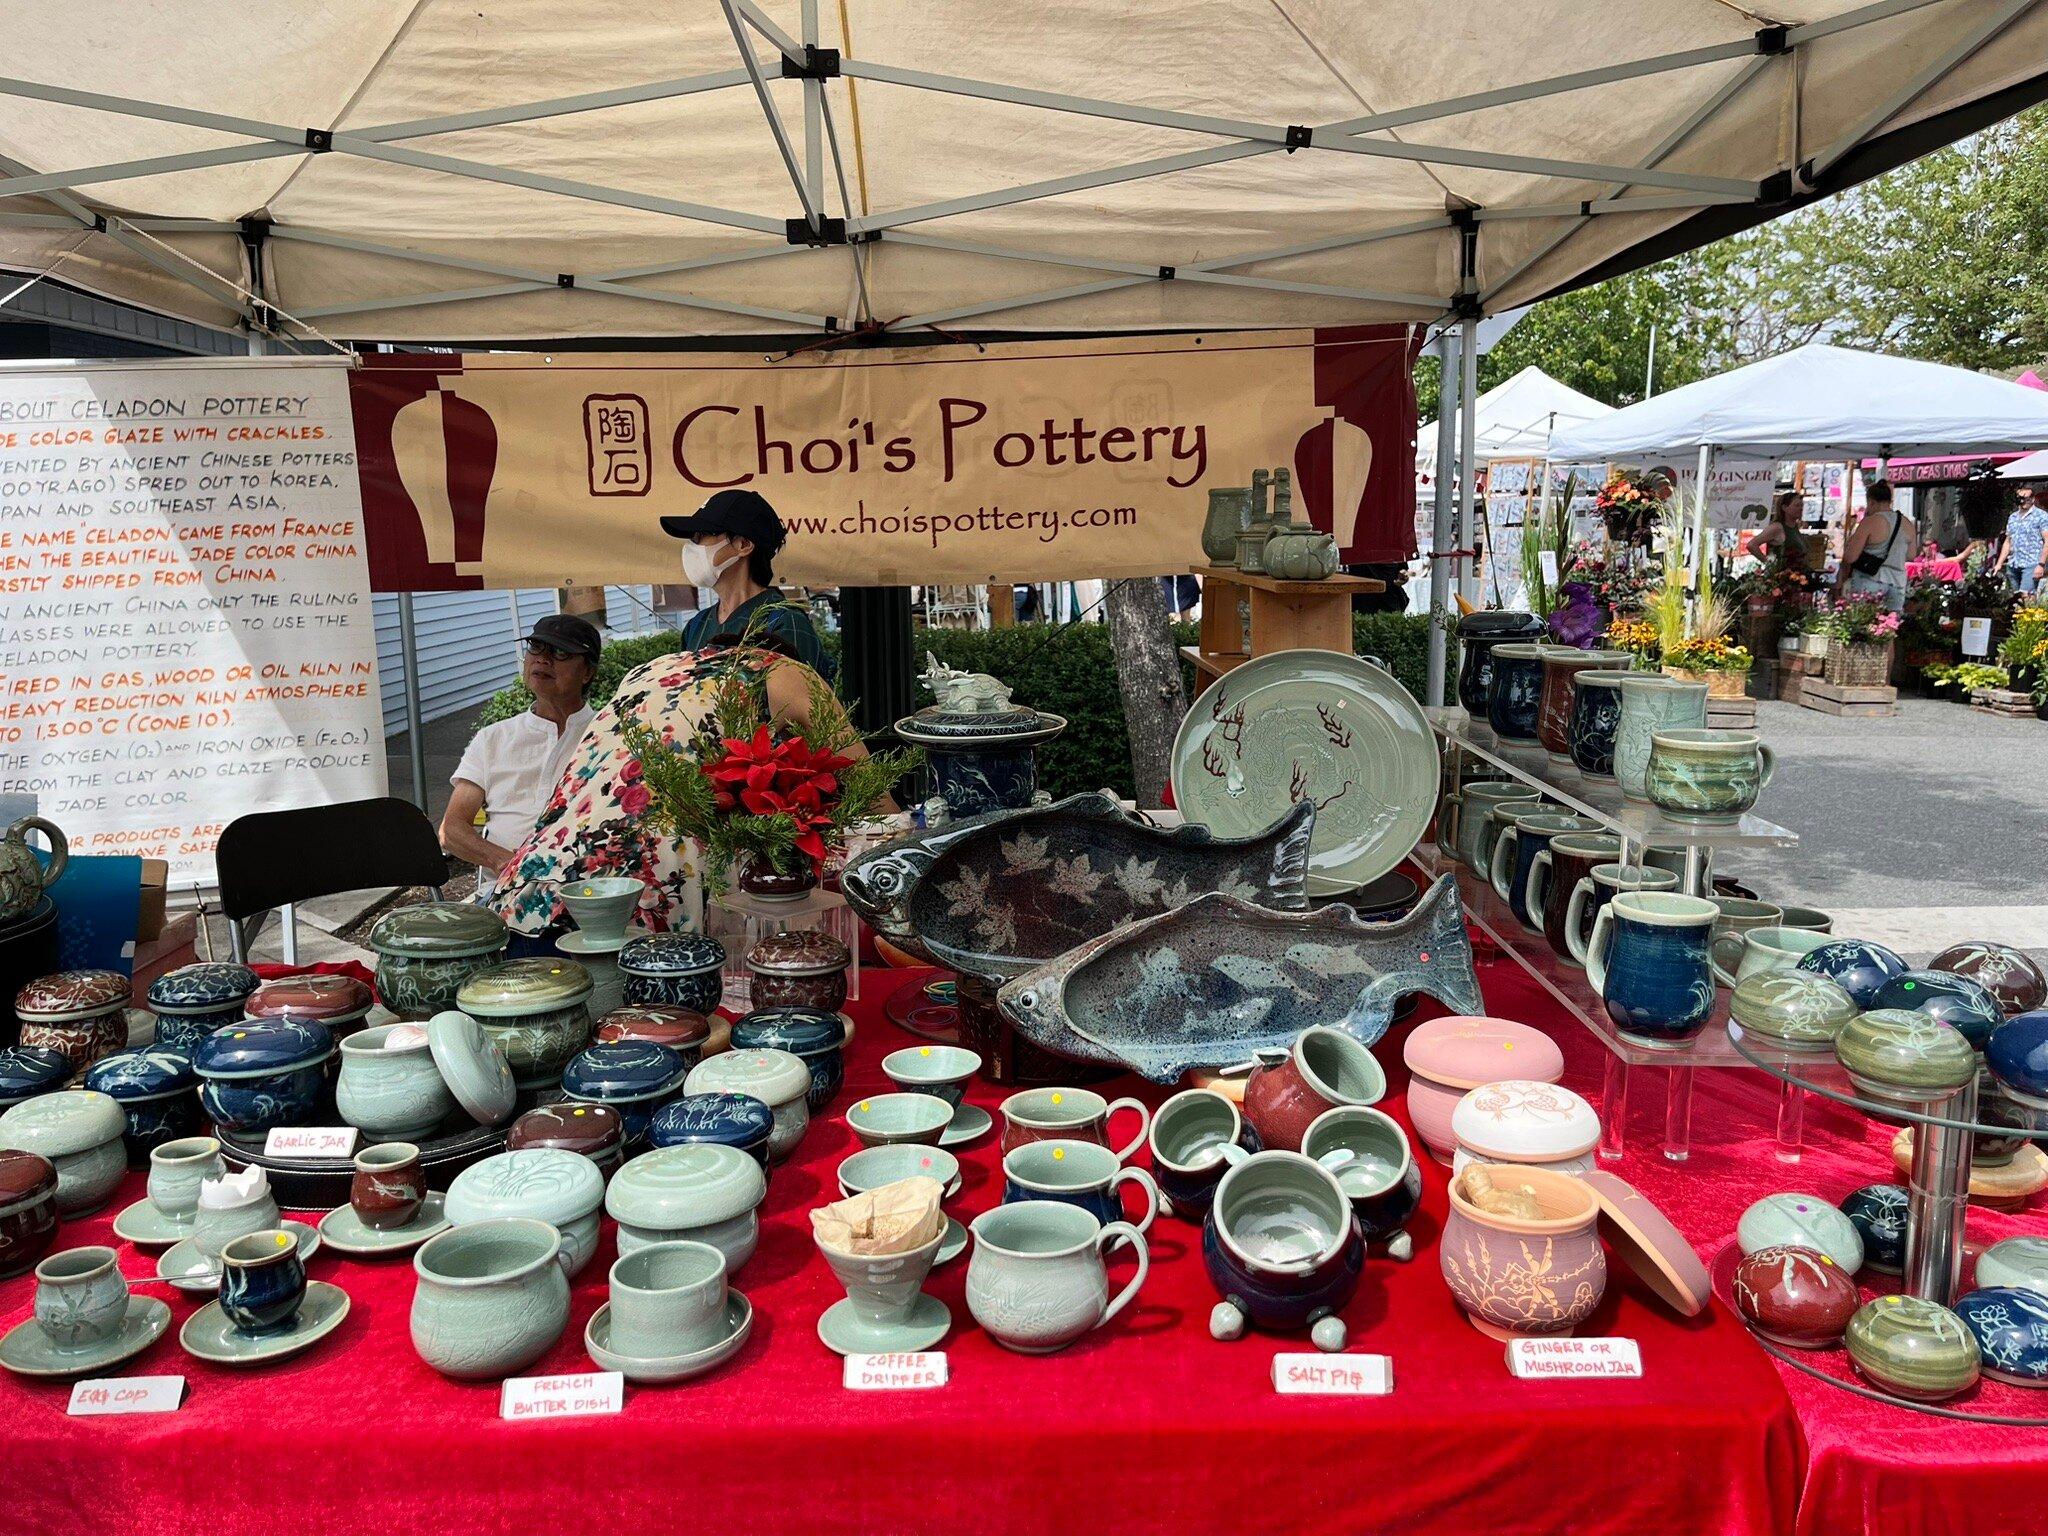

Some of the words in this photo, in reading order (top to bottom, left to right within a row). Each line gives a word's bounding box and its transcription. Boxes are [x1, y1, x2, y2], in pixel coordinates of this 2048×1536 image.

[71, 399, 186, 420] CELADON
[203, 396, 310, 416] POTTERY
[29, 428, 95, 446] COLOR
[104, 426, 165, 445] GLAZE
[174, 426, 218, 442] WITH
[597, 405, 640, 486] 陶石
[672, 403, 916, 489] Choi's
[939, 397, 1207, 488] Pottery
[78, 456, 103, 473] BY
[109, 455, 191, 471] ANCIENT
[201, 450, 274, 468] CHINESE
[281, 451, 355, 467] POTTERS
[125, 476, 188, 492] SPRED
[199, 475, 234, 491] OUT
[240, 475, 260, 488] TO
[56, 502, 94, 518] AND
[109, 497, 217, 515] SOUTHEAST
[22, 529, 76, 547] NAME
[178, 524, 224, 542] CAME
[231, 523, 276, 539] FROM
[282, 517, 355, 538] FRANCE
[779, 500, 1138, 549] ww.choispottery.com
[41, 552, 72, 569] THE
[81, 549, 180, 567] BEAUTIFUL
[189, 547, 236, 562] JADE
[244, 545, 297, 560] COLOR
[304, 543, 358, 559] CHINA
[62, 574, 142, 591] SHIPPED
[154, 570, 202, 586] FROM
[24, 602, 113, 619] ANCIENT
[125, 595, 188, 614] CHINA
[197, 594, 244, 611] ONLY
[251, 593, 281, 608] THE
[289, 592, 359, 606] RULING
[84, 623, 133, 638] WERE
[146, 619, 232, 636] ALLOWED
[242, 617, 264, 630] TO
[273, 615, 306, 629] USE
[315, 613, 350, 628] THE
[0, 649, 88, 668] ELADON
[70, 675, 92, 691] IN
[226, 665, 253, 683] OR
[261, 662, 290, 680] OIL
[300, 662, 343, 677] KILN
[350, 661, 372, 675] IN
[74, 692, 185, 713] REDUCTION
[196, 690, 237, 706] KILN
[244, 683, 368, 701] ATMOSPHERE
[0, 727, 22, 744] TO
[127, 712, 191, 733] (CONE
[0, 753, 30, 771] THE
[42, 749, 119, 767] OXYGEN
[196, 739, 245, 755] IRON
[250, 735, 306, 751] OXIDE
[3, 778, 57, 794] FROM
[67, 774, 102, 788] THE
[115, 768, 158, 785] CLAY
[166, 766, 208, 780] AND
[217, 761, 272, 776] GLAZE
[284, 753, 372, 770] PRODUCE
[55, 796, 108, 814] JADE
[92, 827, 182, 846] PRODUCTS
[192, 823, 223, 838] ARE
[178, 840, 217, 855] SAFE
[319, 1135, 346, 1149] JAR
[1521, 1341, 1584, 1355] GINGER
[1590, 1344, 1611, 1354] OR
[866, 1353, 927, 1369] COFFEE
[1524, 1360, 1606, 1373] MUSHROOM
[1608, 1361, 1636, 1374] JAR
[534, 1376, 593, 1392] FRENCH
[862, 1372, 938, 1385] DRIPPER
[1288, 1366, 1326, 1383] SALT
[513, 1399, 567, 1415] BUTTER
[574, 1397, 611, 1410] DISH
